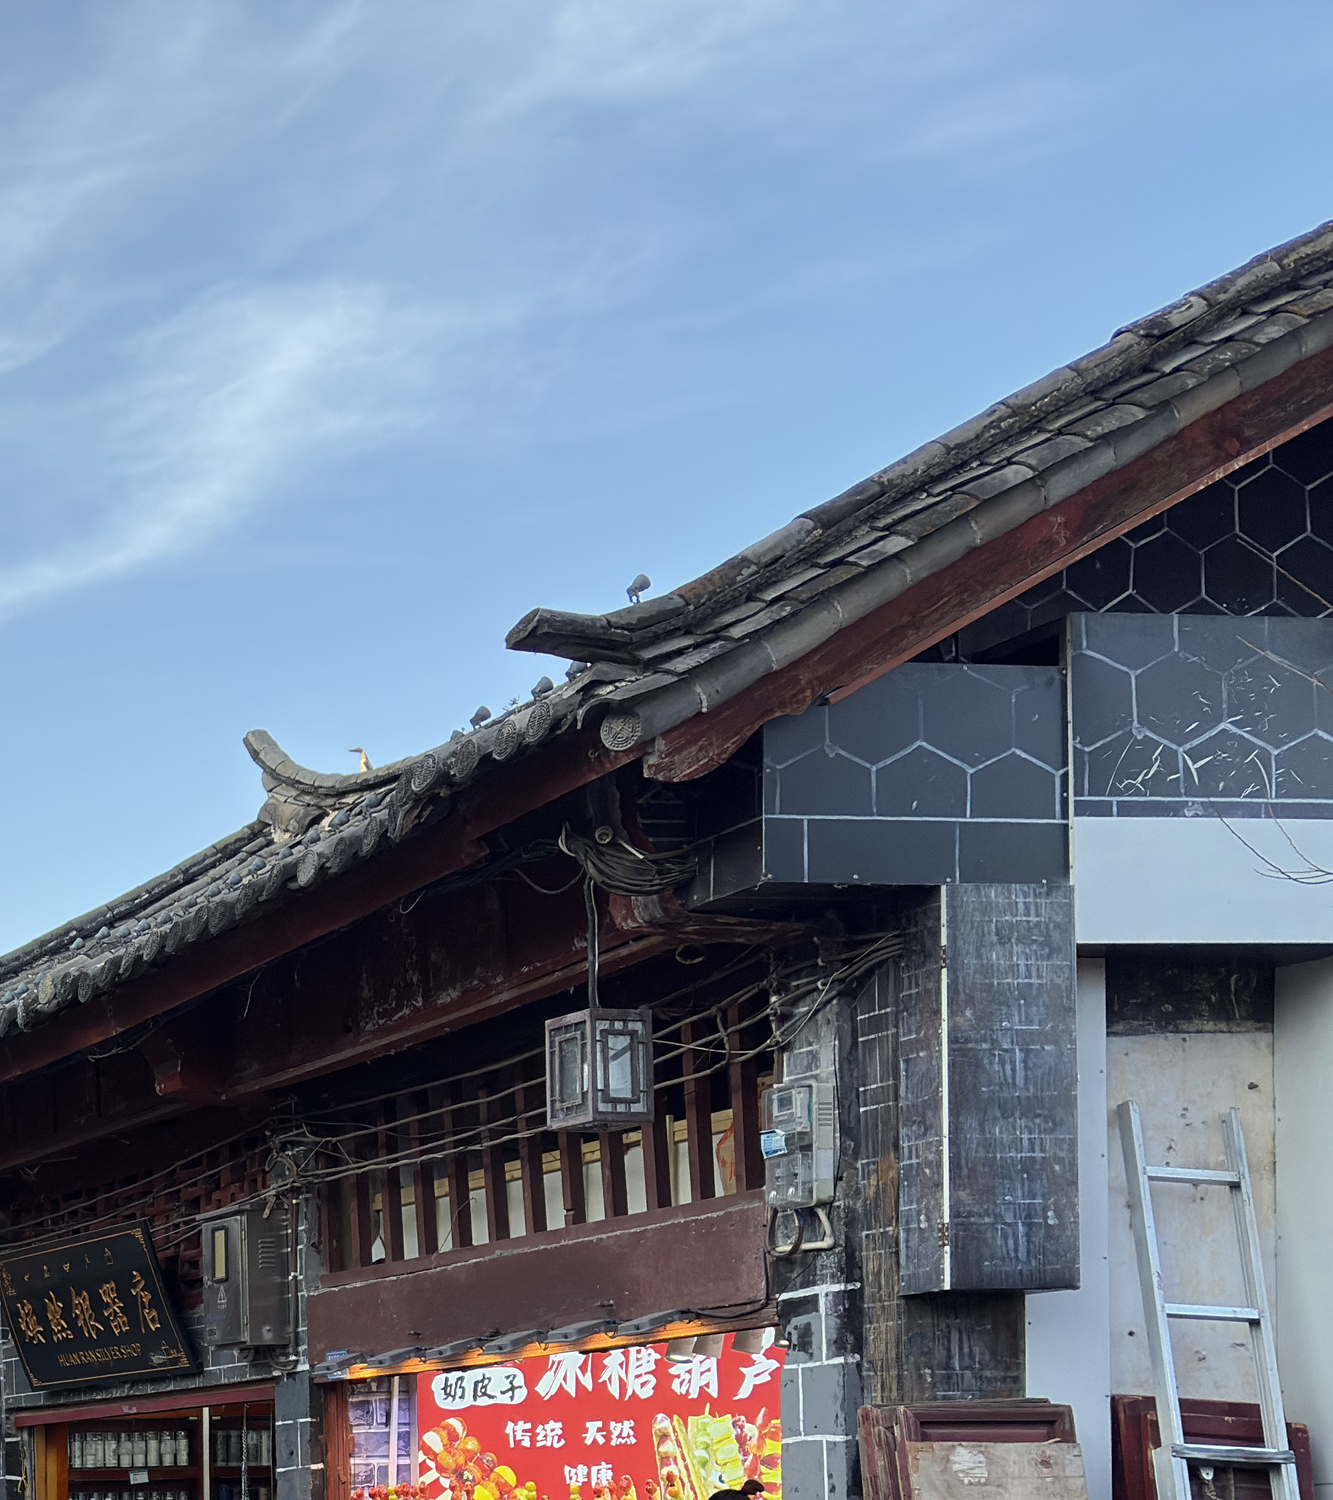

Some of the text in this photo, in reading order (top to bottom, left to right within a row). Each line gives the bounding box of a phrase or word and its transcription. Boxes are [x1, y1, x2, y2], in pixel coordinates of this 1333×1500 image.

[17, 1270, 161, 1344] 焕然银器店
[57, 1343, 142, 1367] HUAN RAN SILVER SHOP
[440, 1373, 525, 1403] 奶皮子
[505, 1420, 637, 1448] 传统 天然
[564, 1461, 613, 1487] 健康
